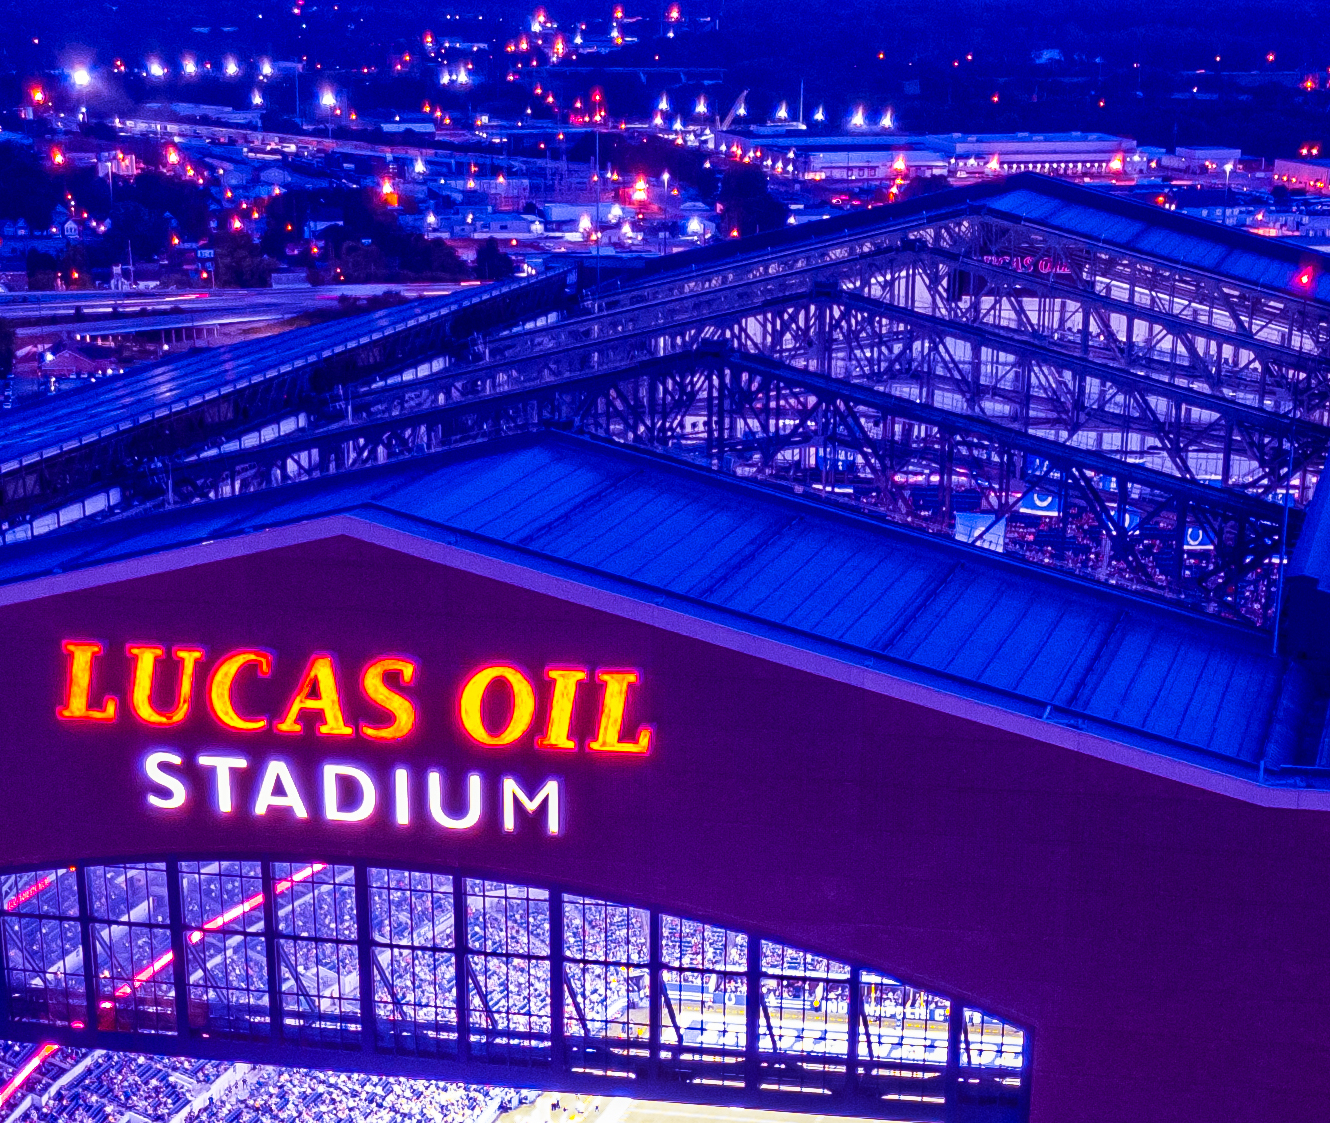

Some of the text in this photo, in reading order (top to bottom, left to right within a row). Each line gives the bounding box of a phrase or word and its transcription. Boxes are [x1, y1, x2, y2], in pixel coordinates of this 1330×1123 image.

[56, 639, 653, 755] LUCAS OIL
[143, 751, 562, 835] STADIUM
[822, 999, 929, 1020] INDNAPOLIS
